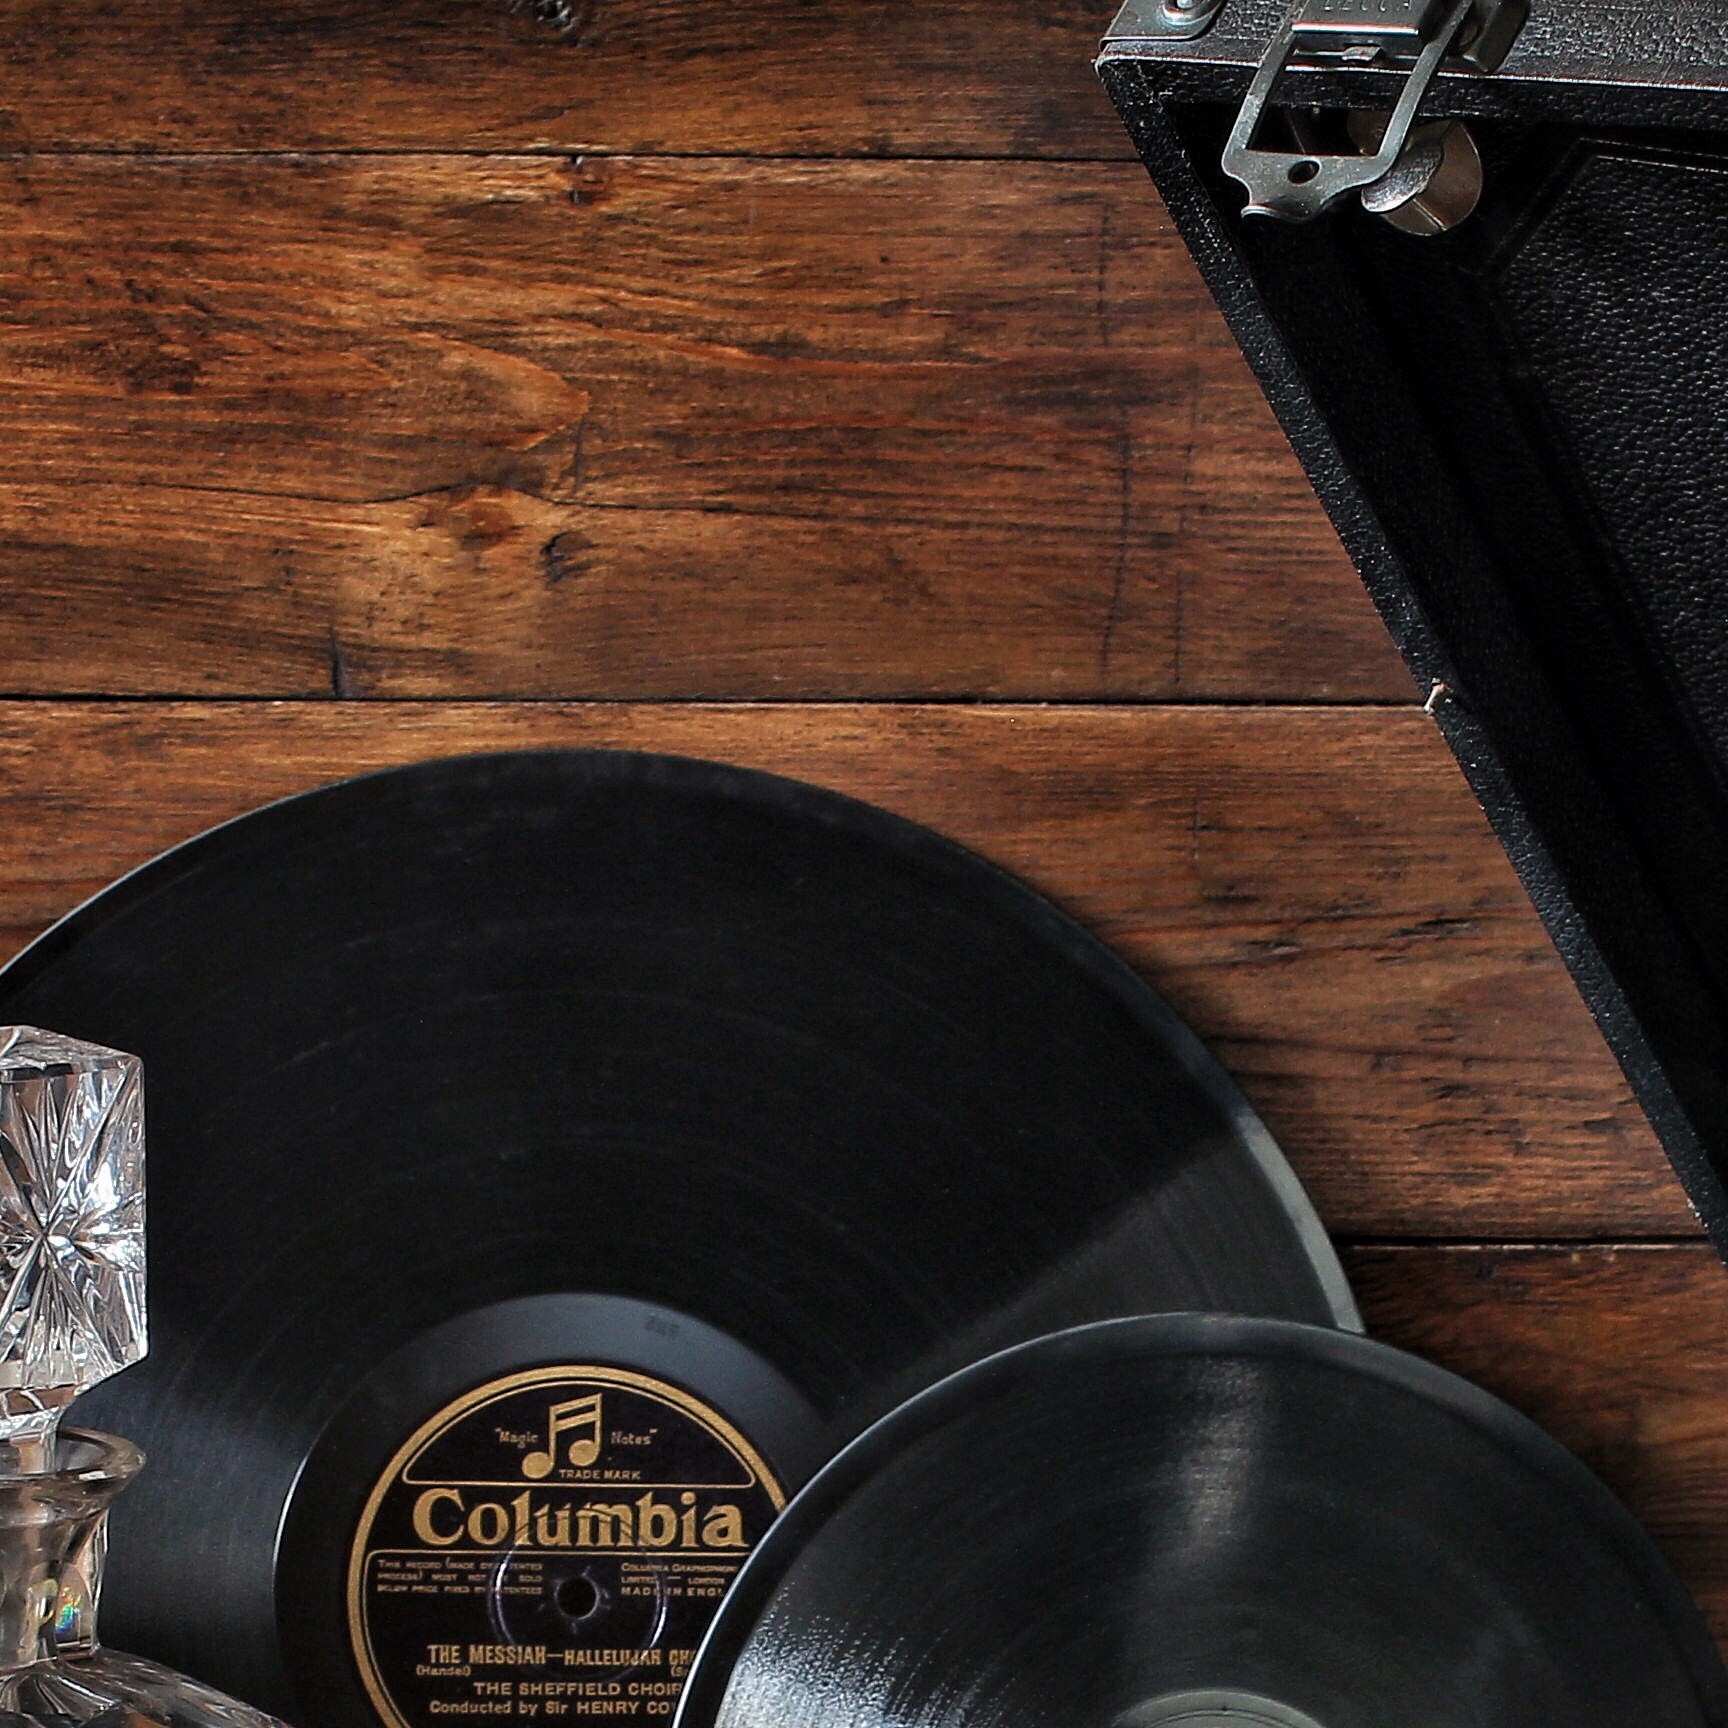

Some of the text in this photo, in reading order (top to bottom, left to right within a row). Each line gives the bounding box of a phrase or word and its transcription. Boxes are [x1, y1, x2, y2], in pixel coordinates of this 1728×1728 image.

[558, 1468, 642, 1481] TRADE MARK
[412, 1486, 751, 1549] Columbia
[426, 1644, 461, 1665] THE
[473, 1681, 512, 1696] THE
[518, 1681, 622, 1697] SHEFFIELD
[429, 1699, 675, 1717] Conducted by Sir HENRY CO
